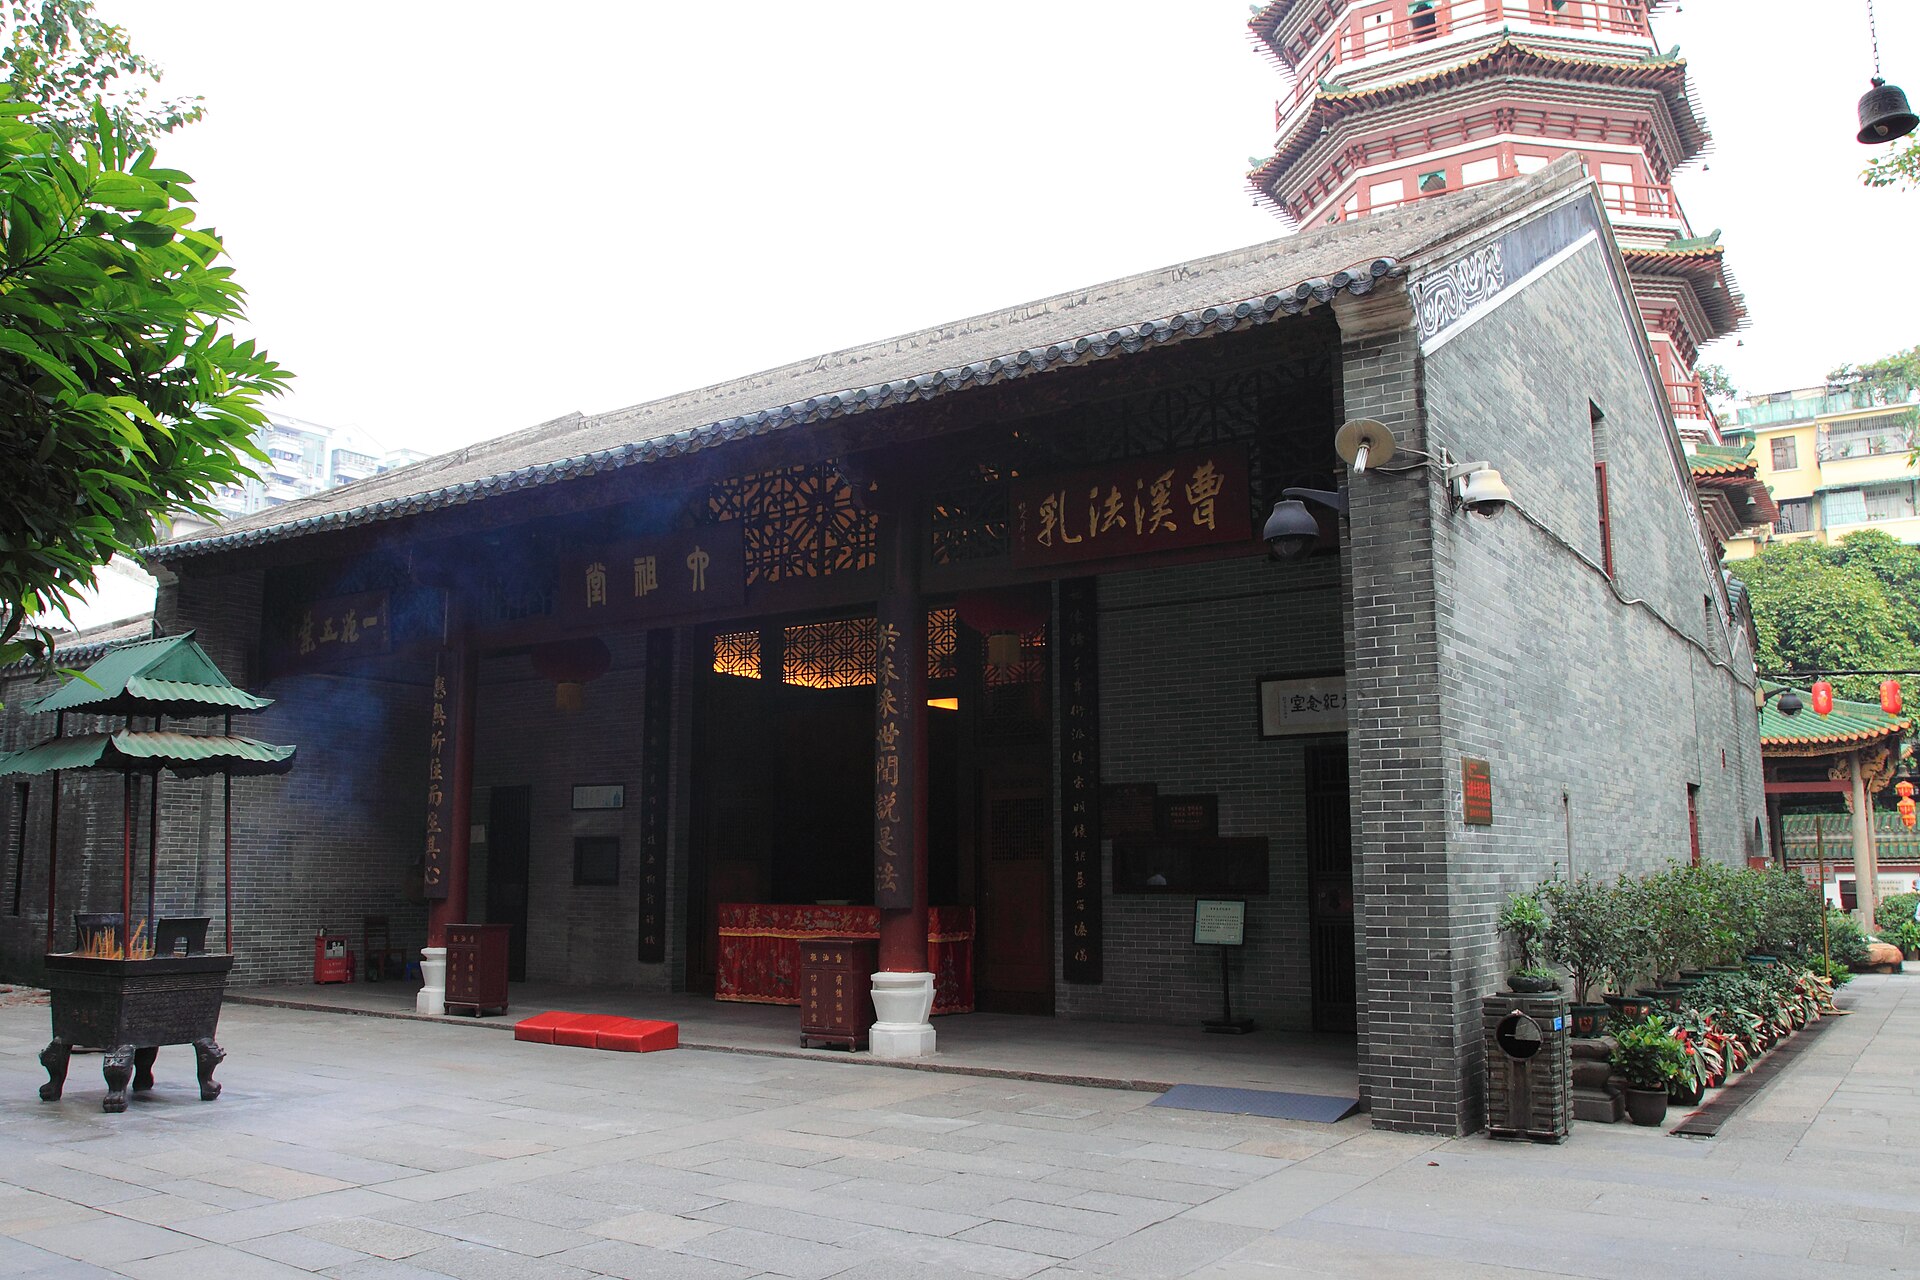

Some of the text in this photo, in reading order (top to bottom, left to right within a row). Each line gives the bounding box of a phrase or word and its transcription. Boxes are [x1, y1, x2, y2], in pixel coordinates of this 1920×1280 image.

[1036, 458, 1226, 548] 曹溪法乳
[585, 545, 710, 609] 六祖堂
[1290, 692, 1347, 713] 紀念室
